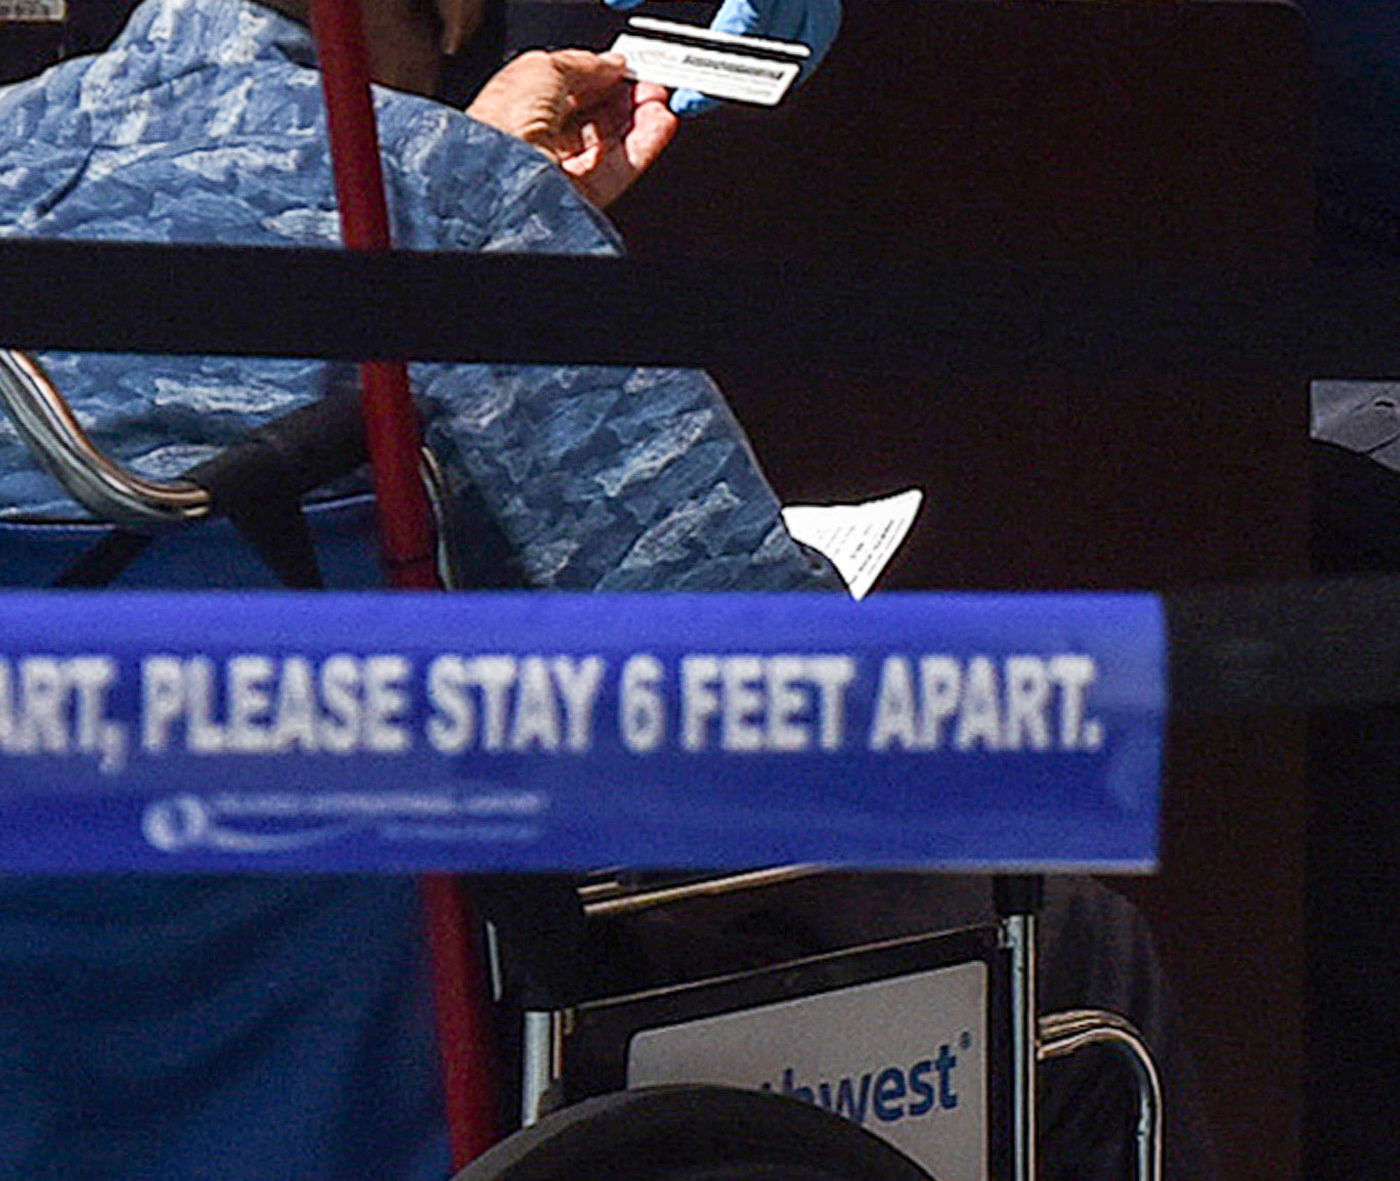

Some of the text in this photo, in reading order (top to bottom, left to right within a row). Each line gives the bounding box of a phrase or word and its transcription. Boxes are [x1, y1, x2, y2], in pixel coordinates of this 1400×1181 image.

[141, 654, 411, 753] PLEASE
[426, 653, 604, 753] STAY
[619, 653, 663, 752] 6
[680, 653, 857, 751] FEET
[869, 652, 1102, 751] APART.
